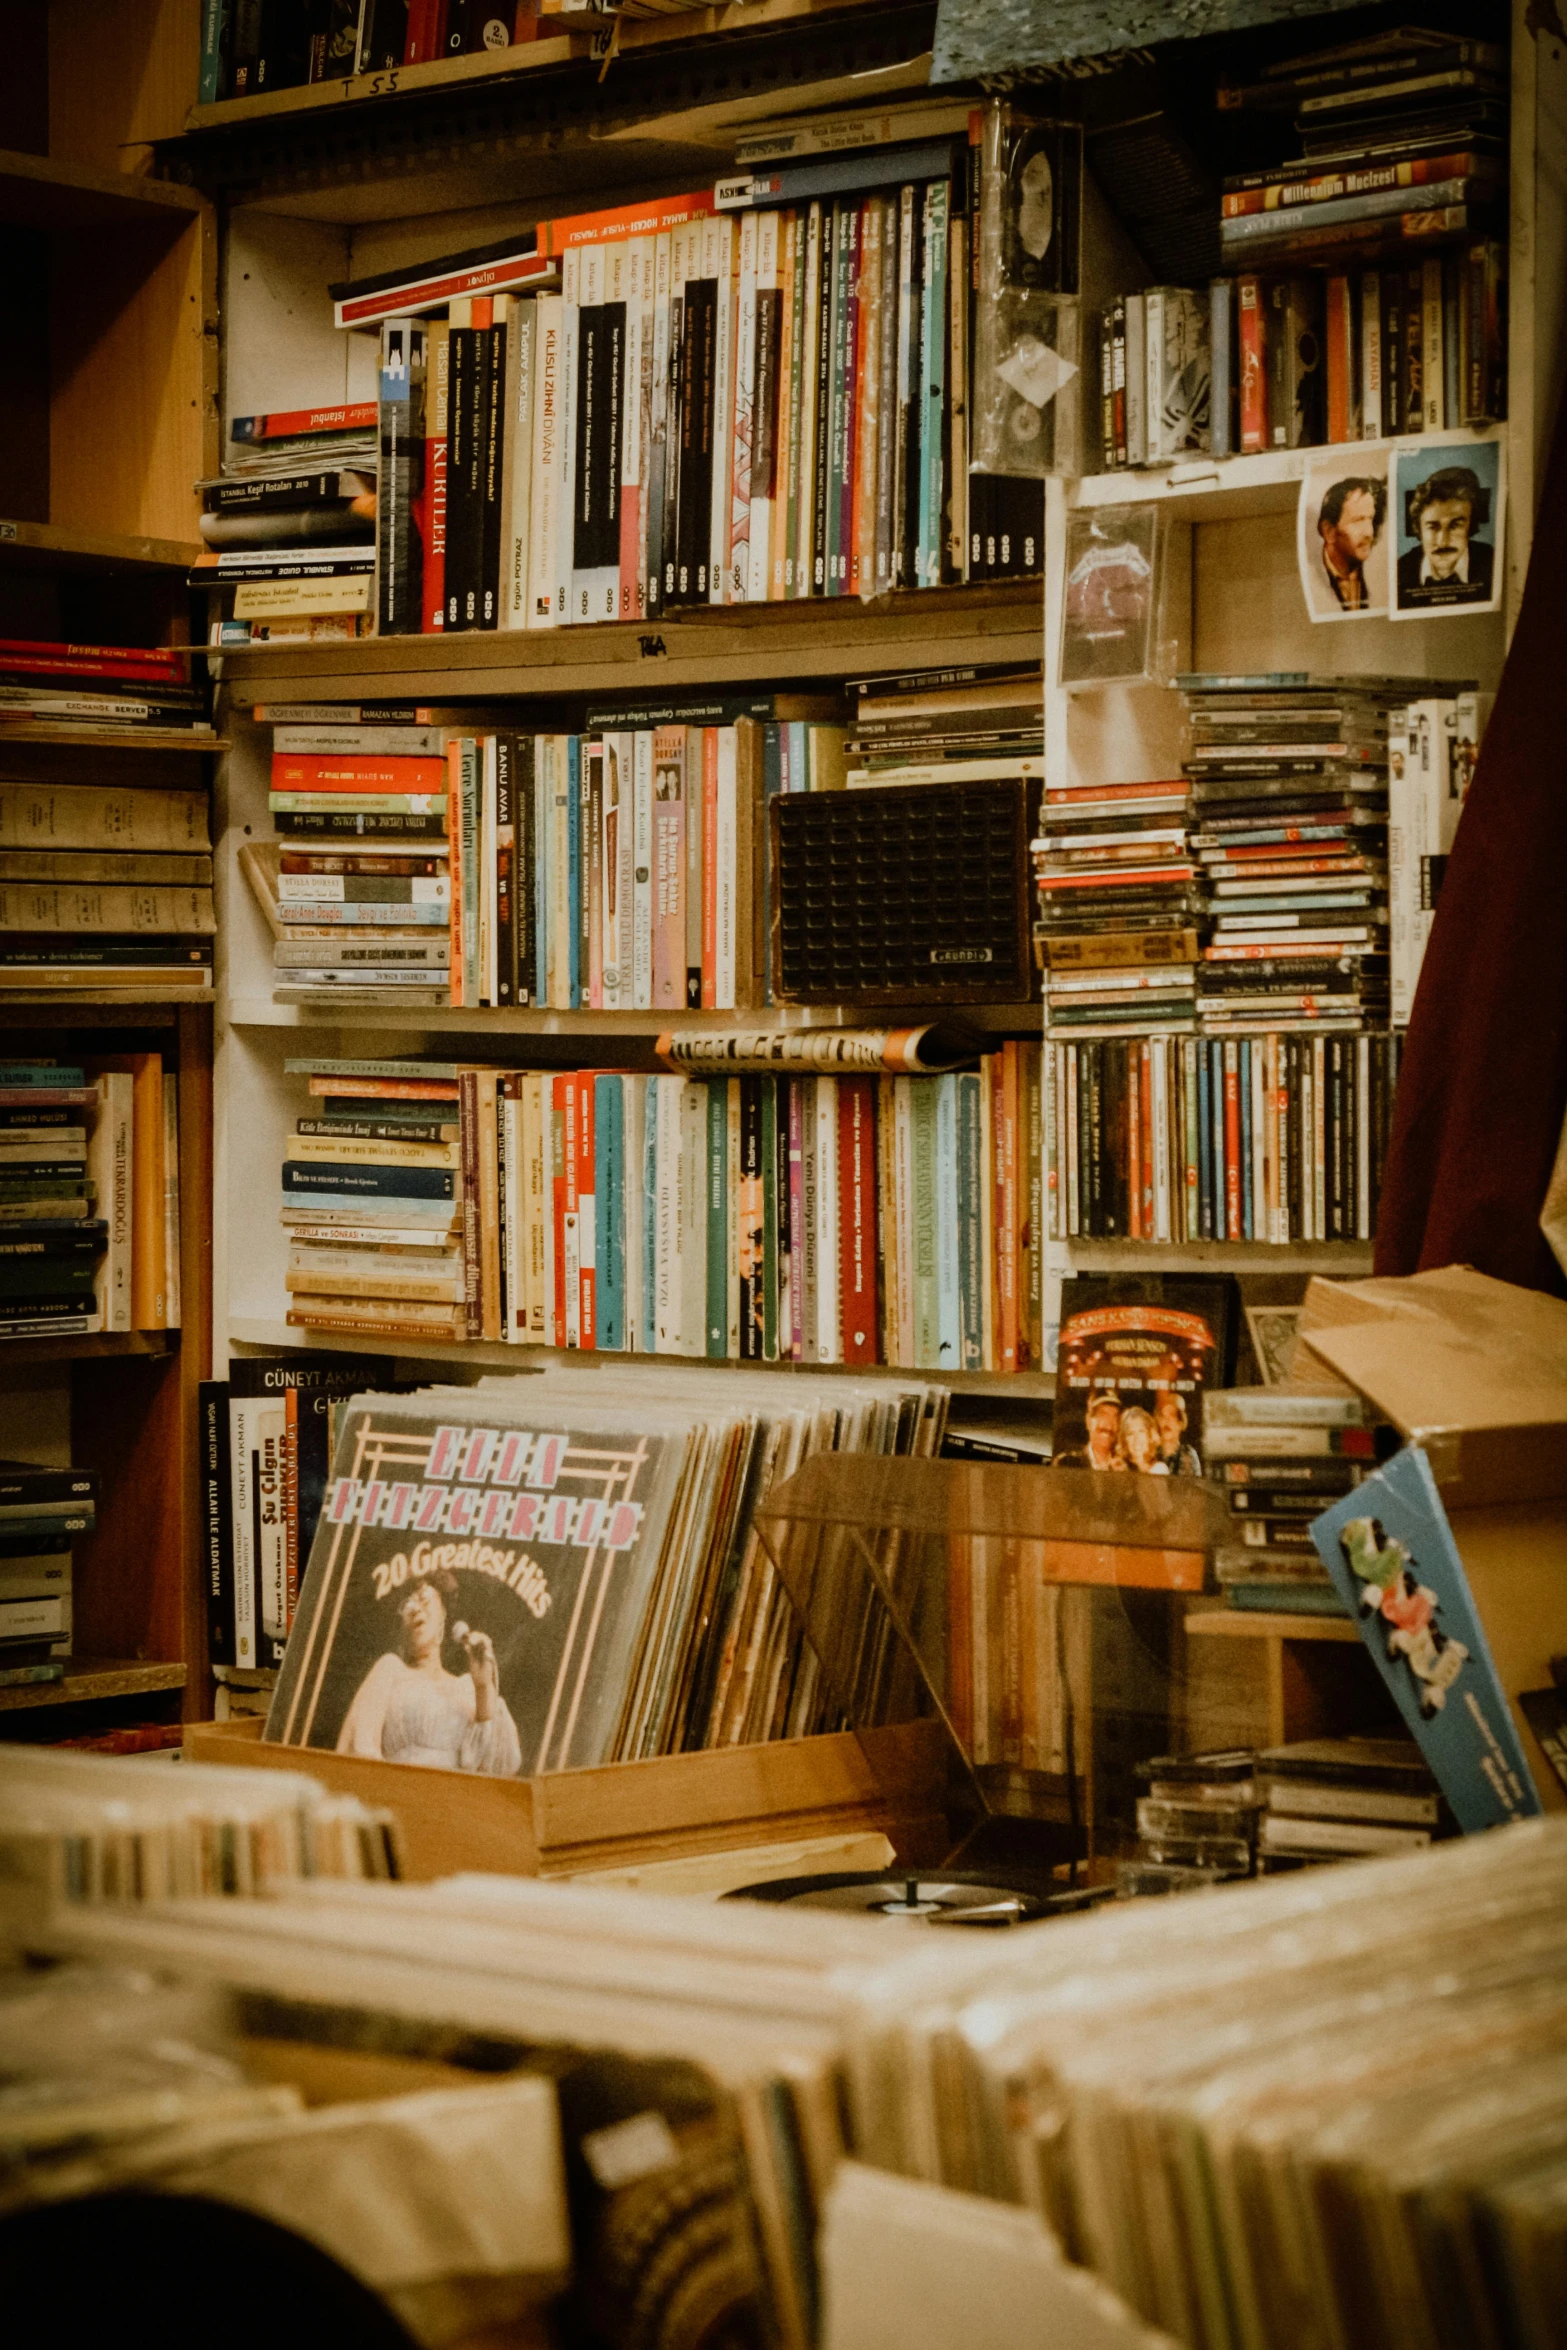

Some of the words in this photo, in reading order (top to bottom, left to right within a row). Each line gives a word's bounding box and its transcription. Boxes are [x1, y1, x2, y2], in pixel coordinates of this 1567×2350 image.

[662, 213, 688, 228] NAMAZ
[519, 320, 530, 368] AMPUL
[546, 330, 556, 377] KİLİSLİ
[518, 374, 528, 422] PATLAK
[247, 484, 264, 496] Keşif
[498, 745, 508, 785] BANU
[498, 787, 508, 822] AVAR
[804, 1186, 815, 1228] Dünya
[806, 1232, 816, 1277] Düzeni
[265, 1369, 322, 1388] CÜNEYT
[324, 1372, 378, 1385] AKMAN
[261, 1438, 278, 1495] Çılgın
[424, 1425, 569, 1491] ELLA
[209, 1517, 220, 1533] İLE
[262, 1501, 276, 1525] Şu
[326, 1477, 644, 1551] FITZGERALD
[210, 1536, 220, 1596] ALDATMAK
[371, 1556, 407, 1601] 20
[411, 1538, 511, 1585] Greatest
[509, 1553, 554, 1620] Hits
